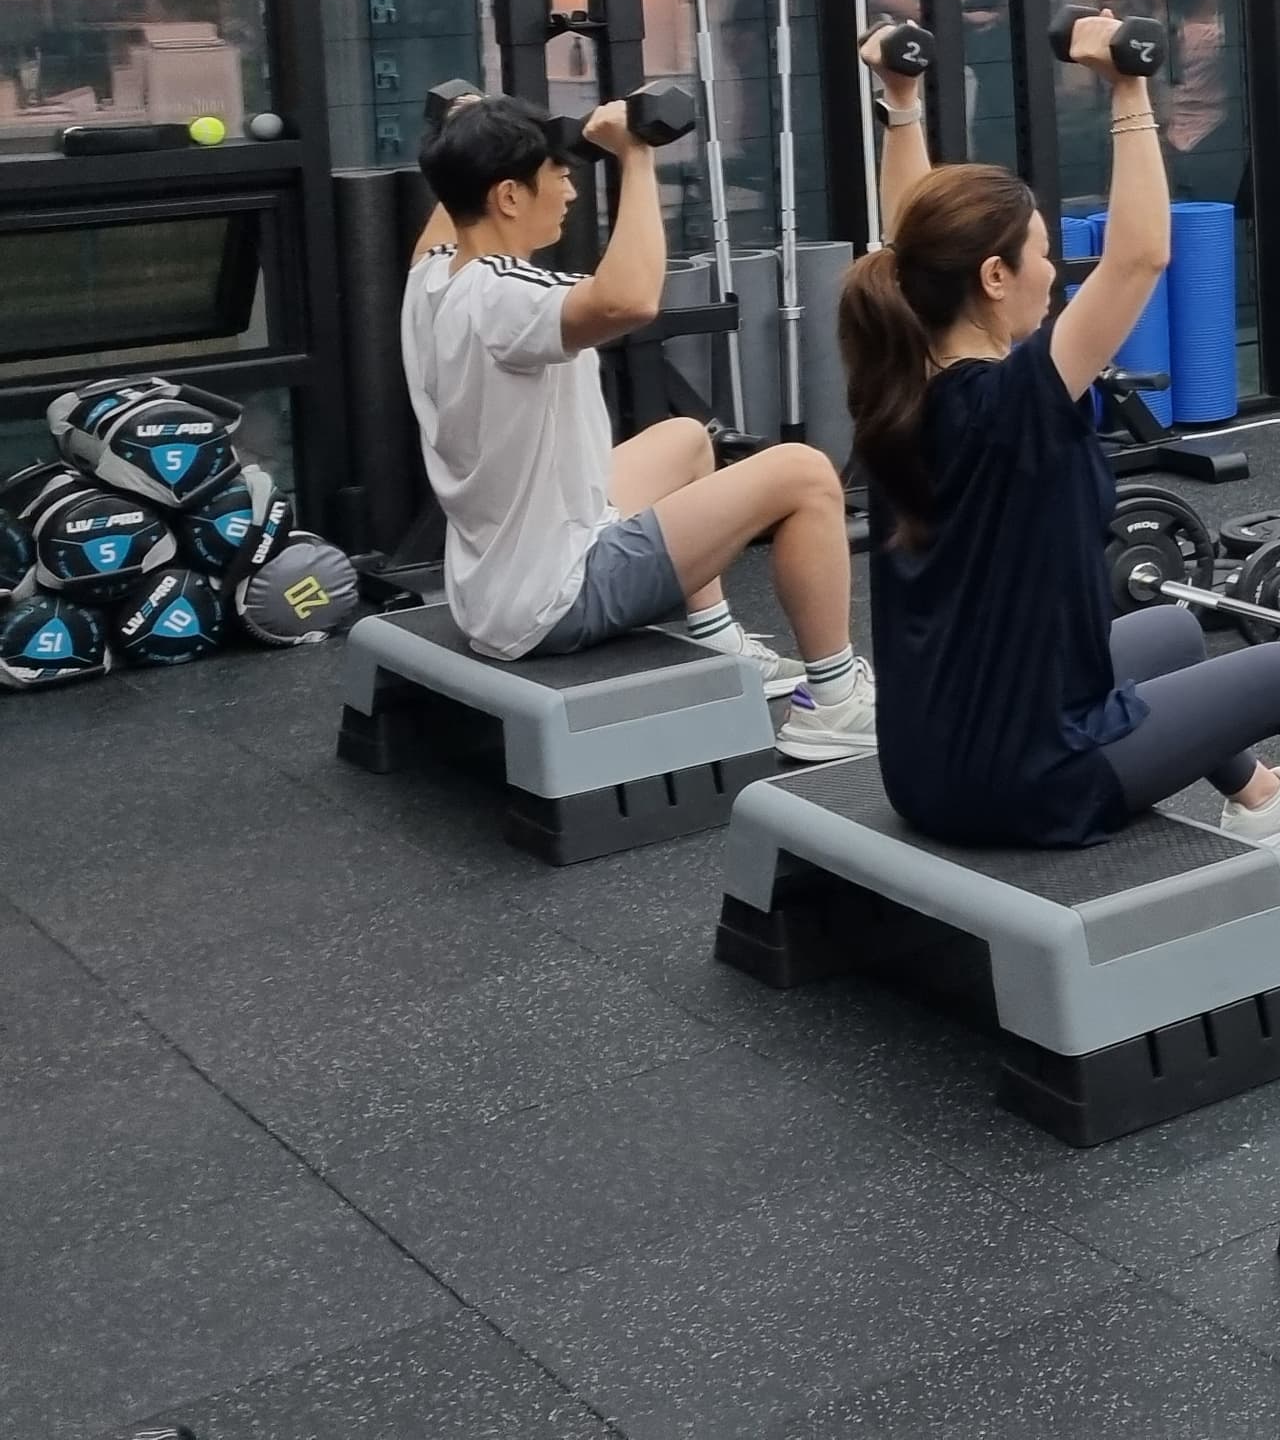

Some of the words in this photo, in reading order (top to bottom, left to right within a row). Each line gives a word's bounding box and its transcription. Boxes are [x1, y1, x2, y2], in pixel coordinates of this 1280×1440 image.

[136, 422, 214, 437] LIVEPRO
[165, 450, 183, 471] 5
[65, 511, 144, 534] LIVEPRO
[99, 542, 116, 564] 5
[283, 575, 331, 620] 20
[163, 609, 192, 633] 10
